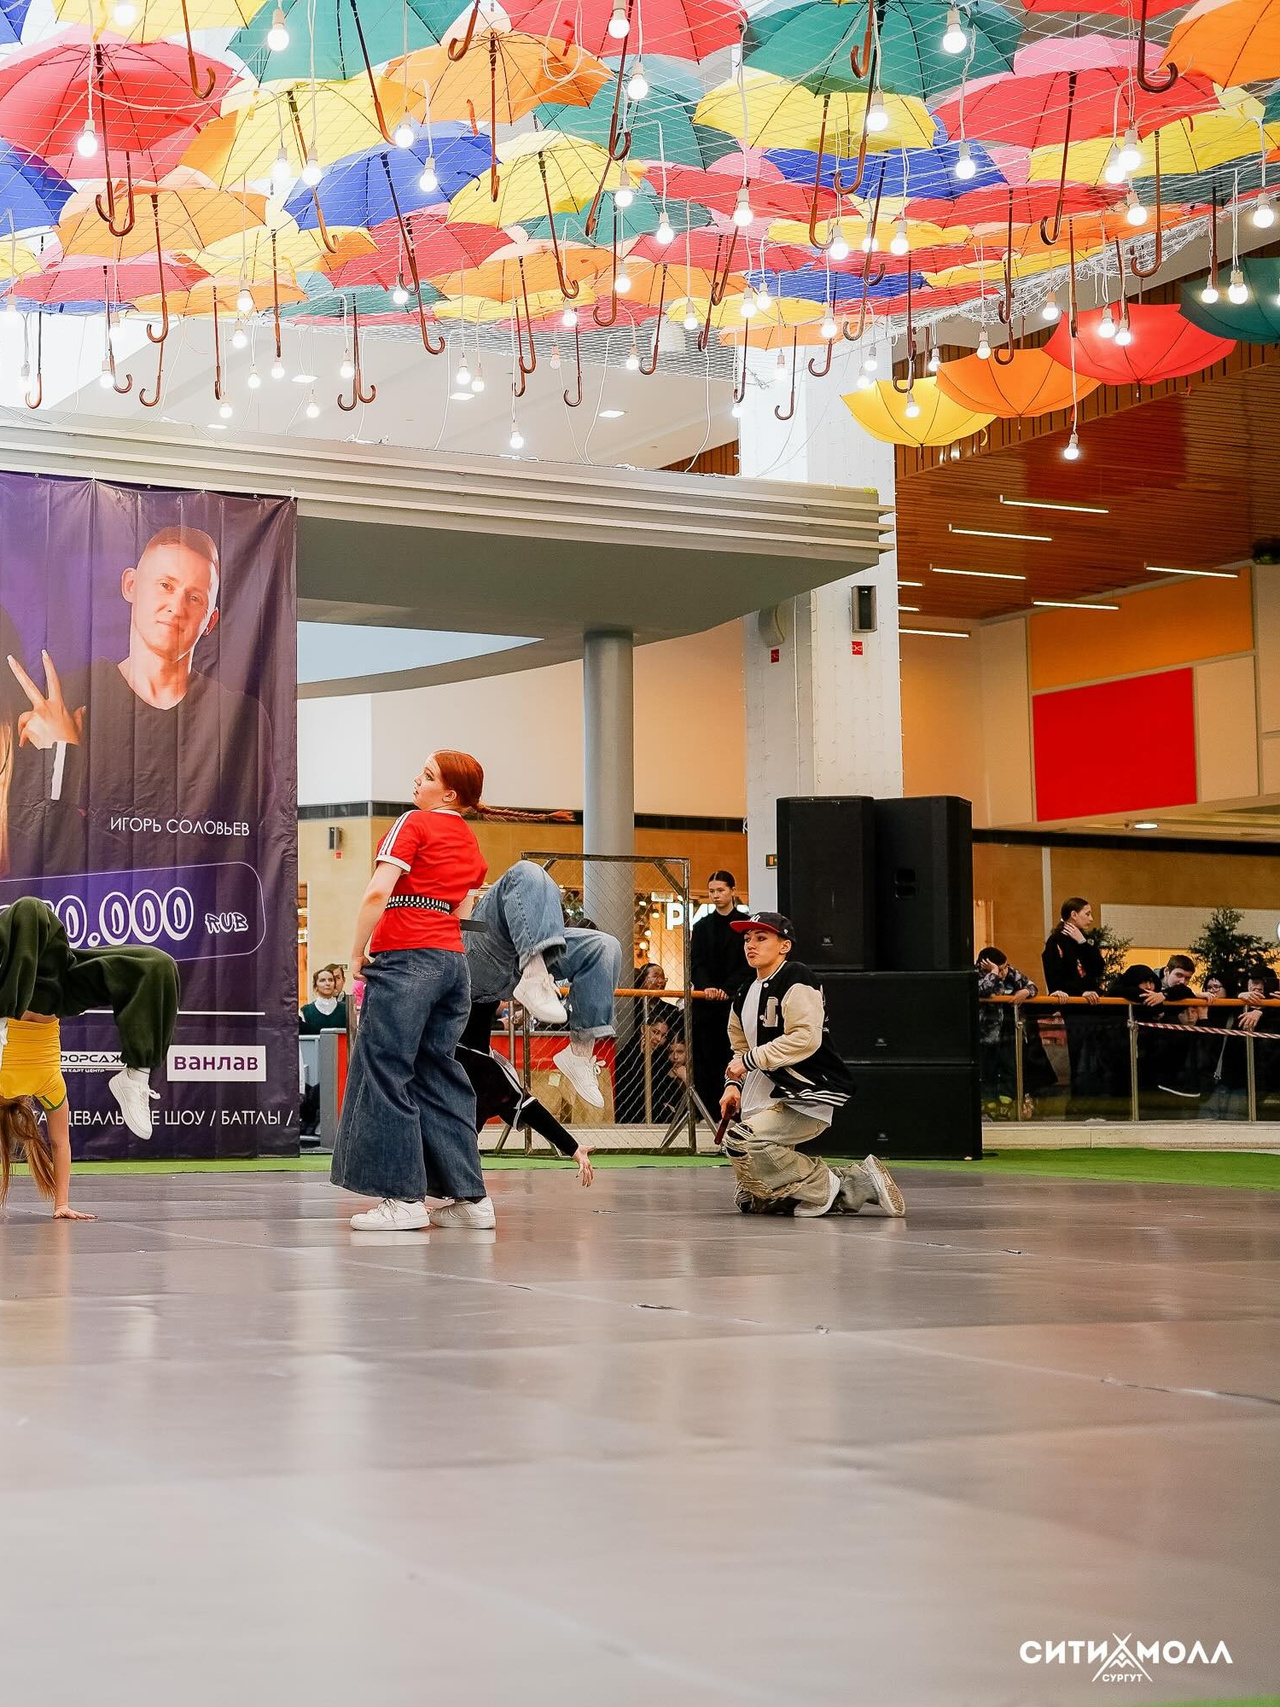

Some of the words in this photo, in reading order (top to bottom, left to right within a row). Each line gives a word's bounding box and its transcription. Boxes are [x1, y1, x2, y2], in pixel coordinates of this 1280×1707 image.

[110, 816, 162, 834] ИГОРЬ
[166, 817, 250, 836] СОЛОВЬЕВ
[205, 912, 249, 934] RUB
[174, 1055, 259, 1072] ванлав
[164, 1110, 205, 1126] ШОУ
[221, 1110, 281, 1126] БАТТЛЫ
